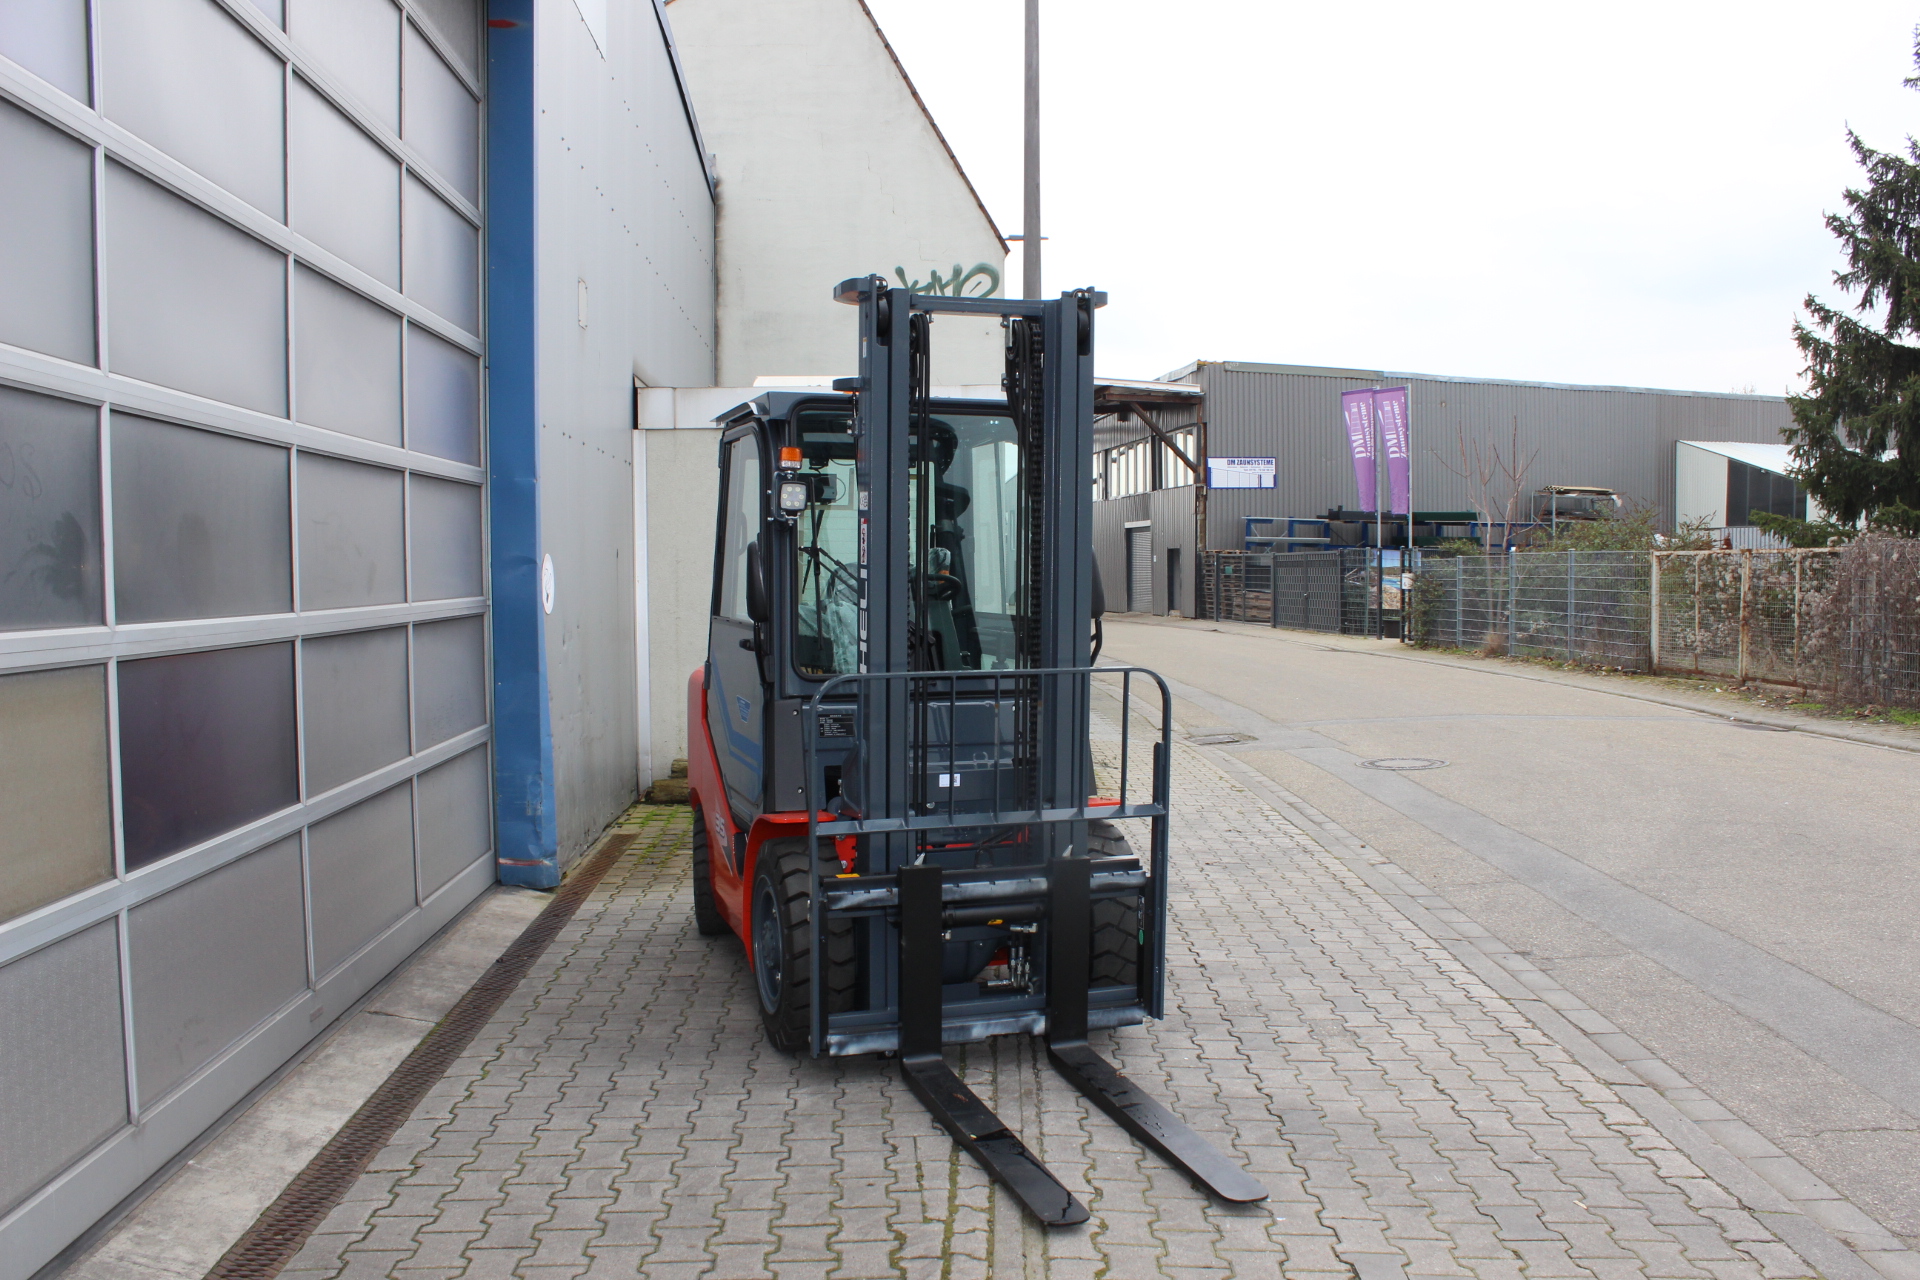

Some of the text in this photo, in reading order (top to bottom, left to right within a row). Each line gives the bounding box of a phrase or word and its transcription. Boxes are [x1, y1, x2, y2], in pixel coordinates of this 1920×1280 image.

[1351, 434, 1367, 458] DM
[1360, 402, 1371, 458] Zaunsysteme
[1385, 434, 1400, 458] DM
[1392, 400, 1407, 459] Zaunsysteme
[859, 568, 868, 674] HELI
